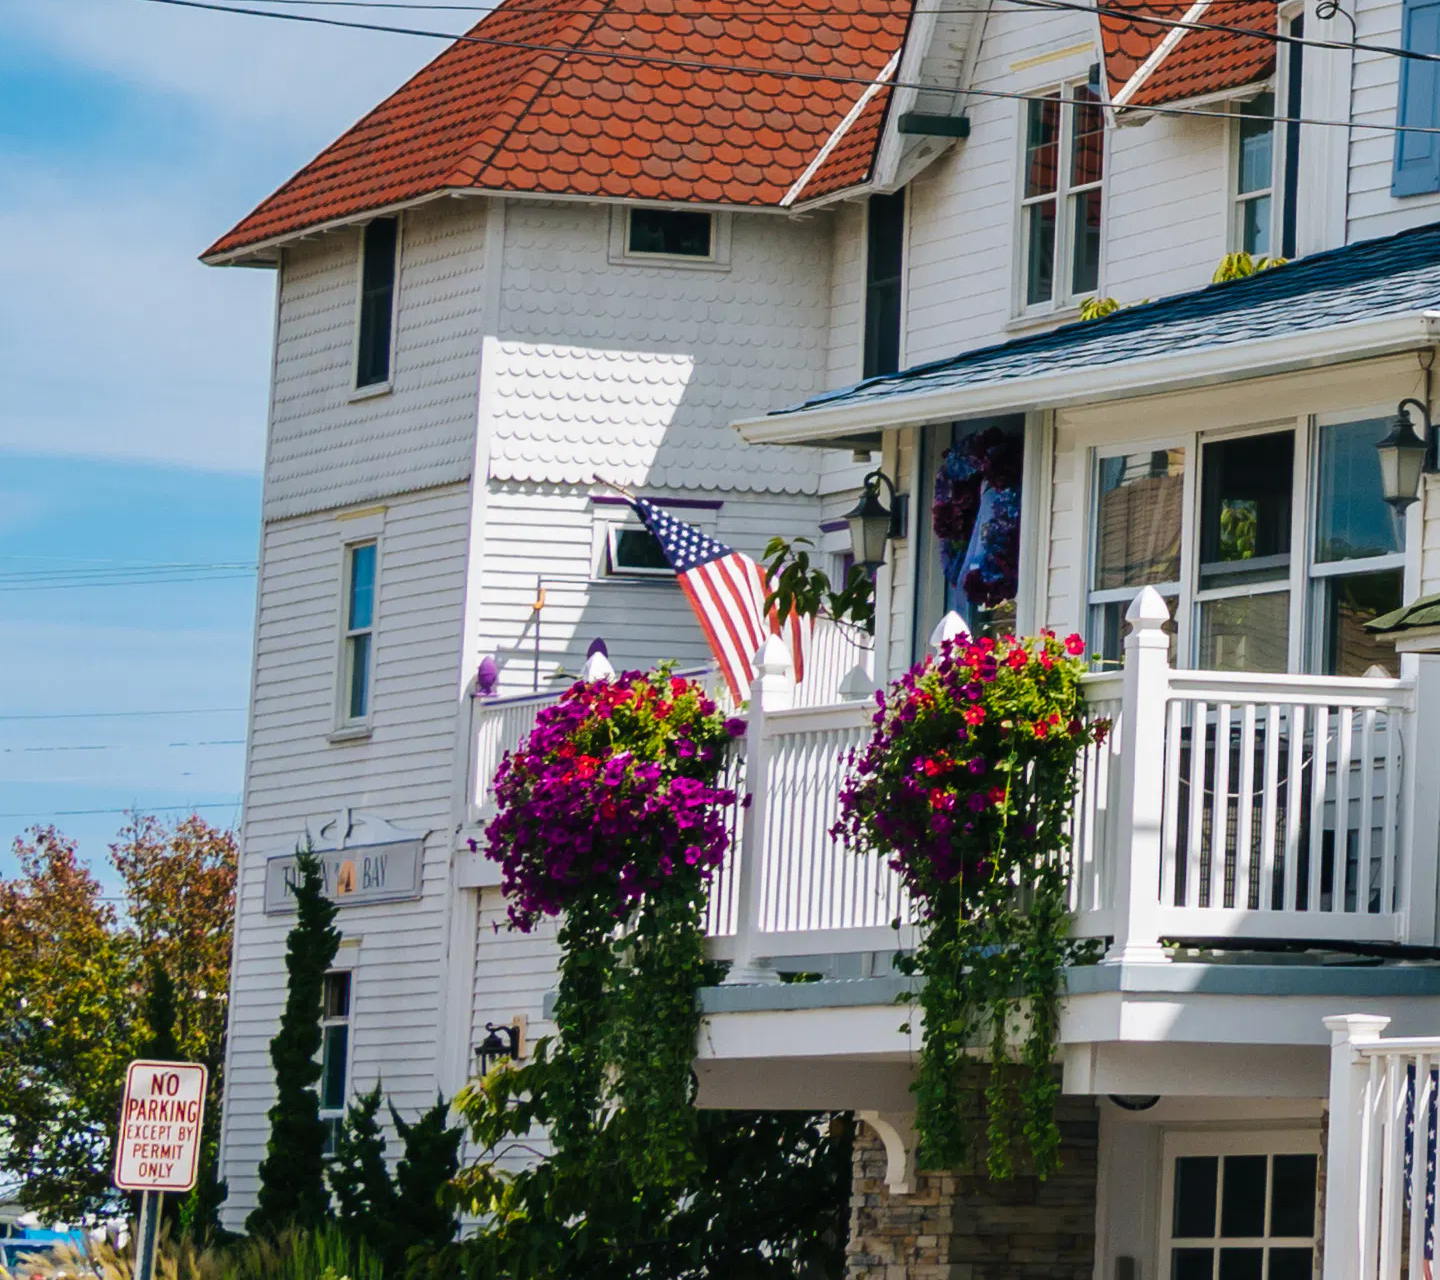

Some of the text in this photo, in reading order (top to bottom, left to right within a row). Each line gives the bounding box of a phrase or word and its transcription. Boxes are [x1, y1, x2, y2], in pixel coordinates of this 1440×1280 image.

[362, 854, 388, 890] BAY
[151, 1073, 180, 1096] NO
[127, 1098, 198, 1123] PARKING
[127, 1124, 195, 1141] EXCEPT BY
[132, 1143, 184, 1160] PERMIT
[138, 1162, 174, 1178] ONLY
